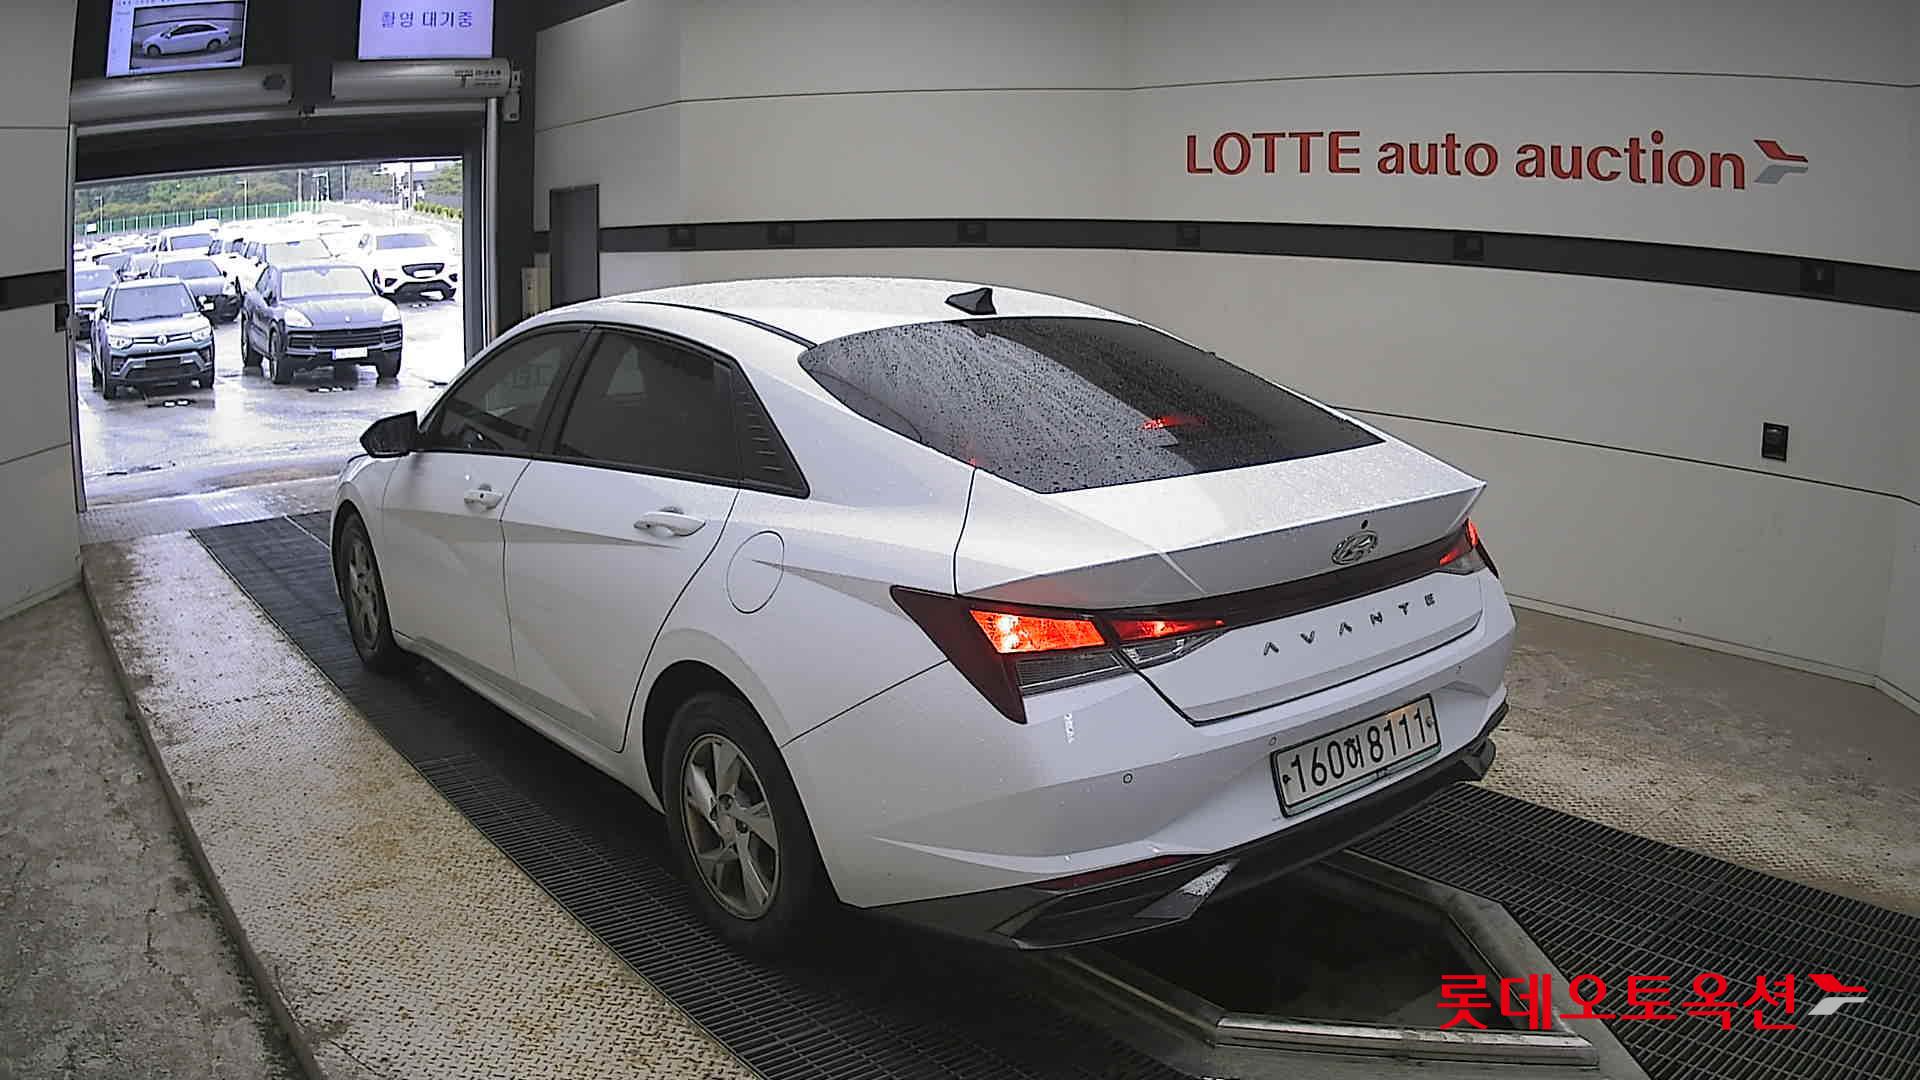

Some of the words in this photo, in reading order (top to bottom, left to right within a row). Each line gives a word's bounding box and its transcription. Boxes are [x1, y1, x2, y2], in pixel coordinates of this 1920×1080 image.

[422, 11, 473, 28] 대기중
[1186, 131, 1361, 175] LOTTE
[1377, 133, 1498, 176] auto
[1515, 130, 1745, 190] auction
[1263, 592, 1436, 656] AVANTE
